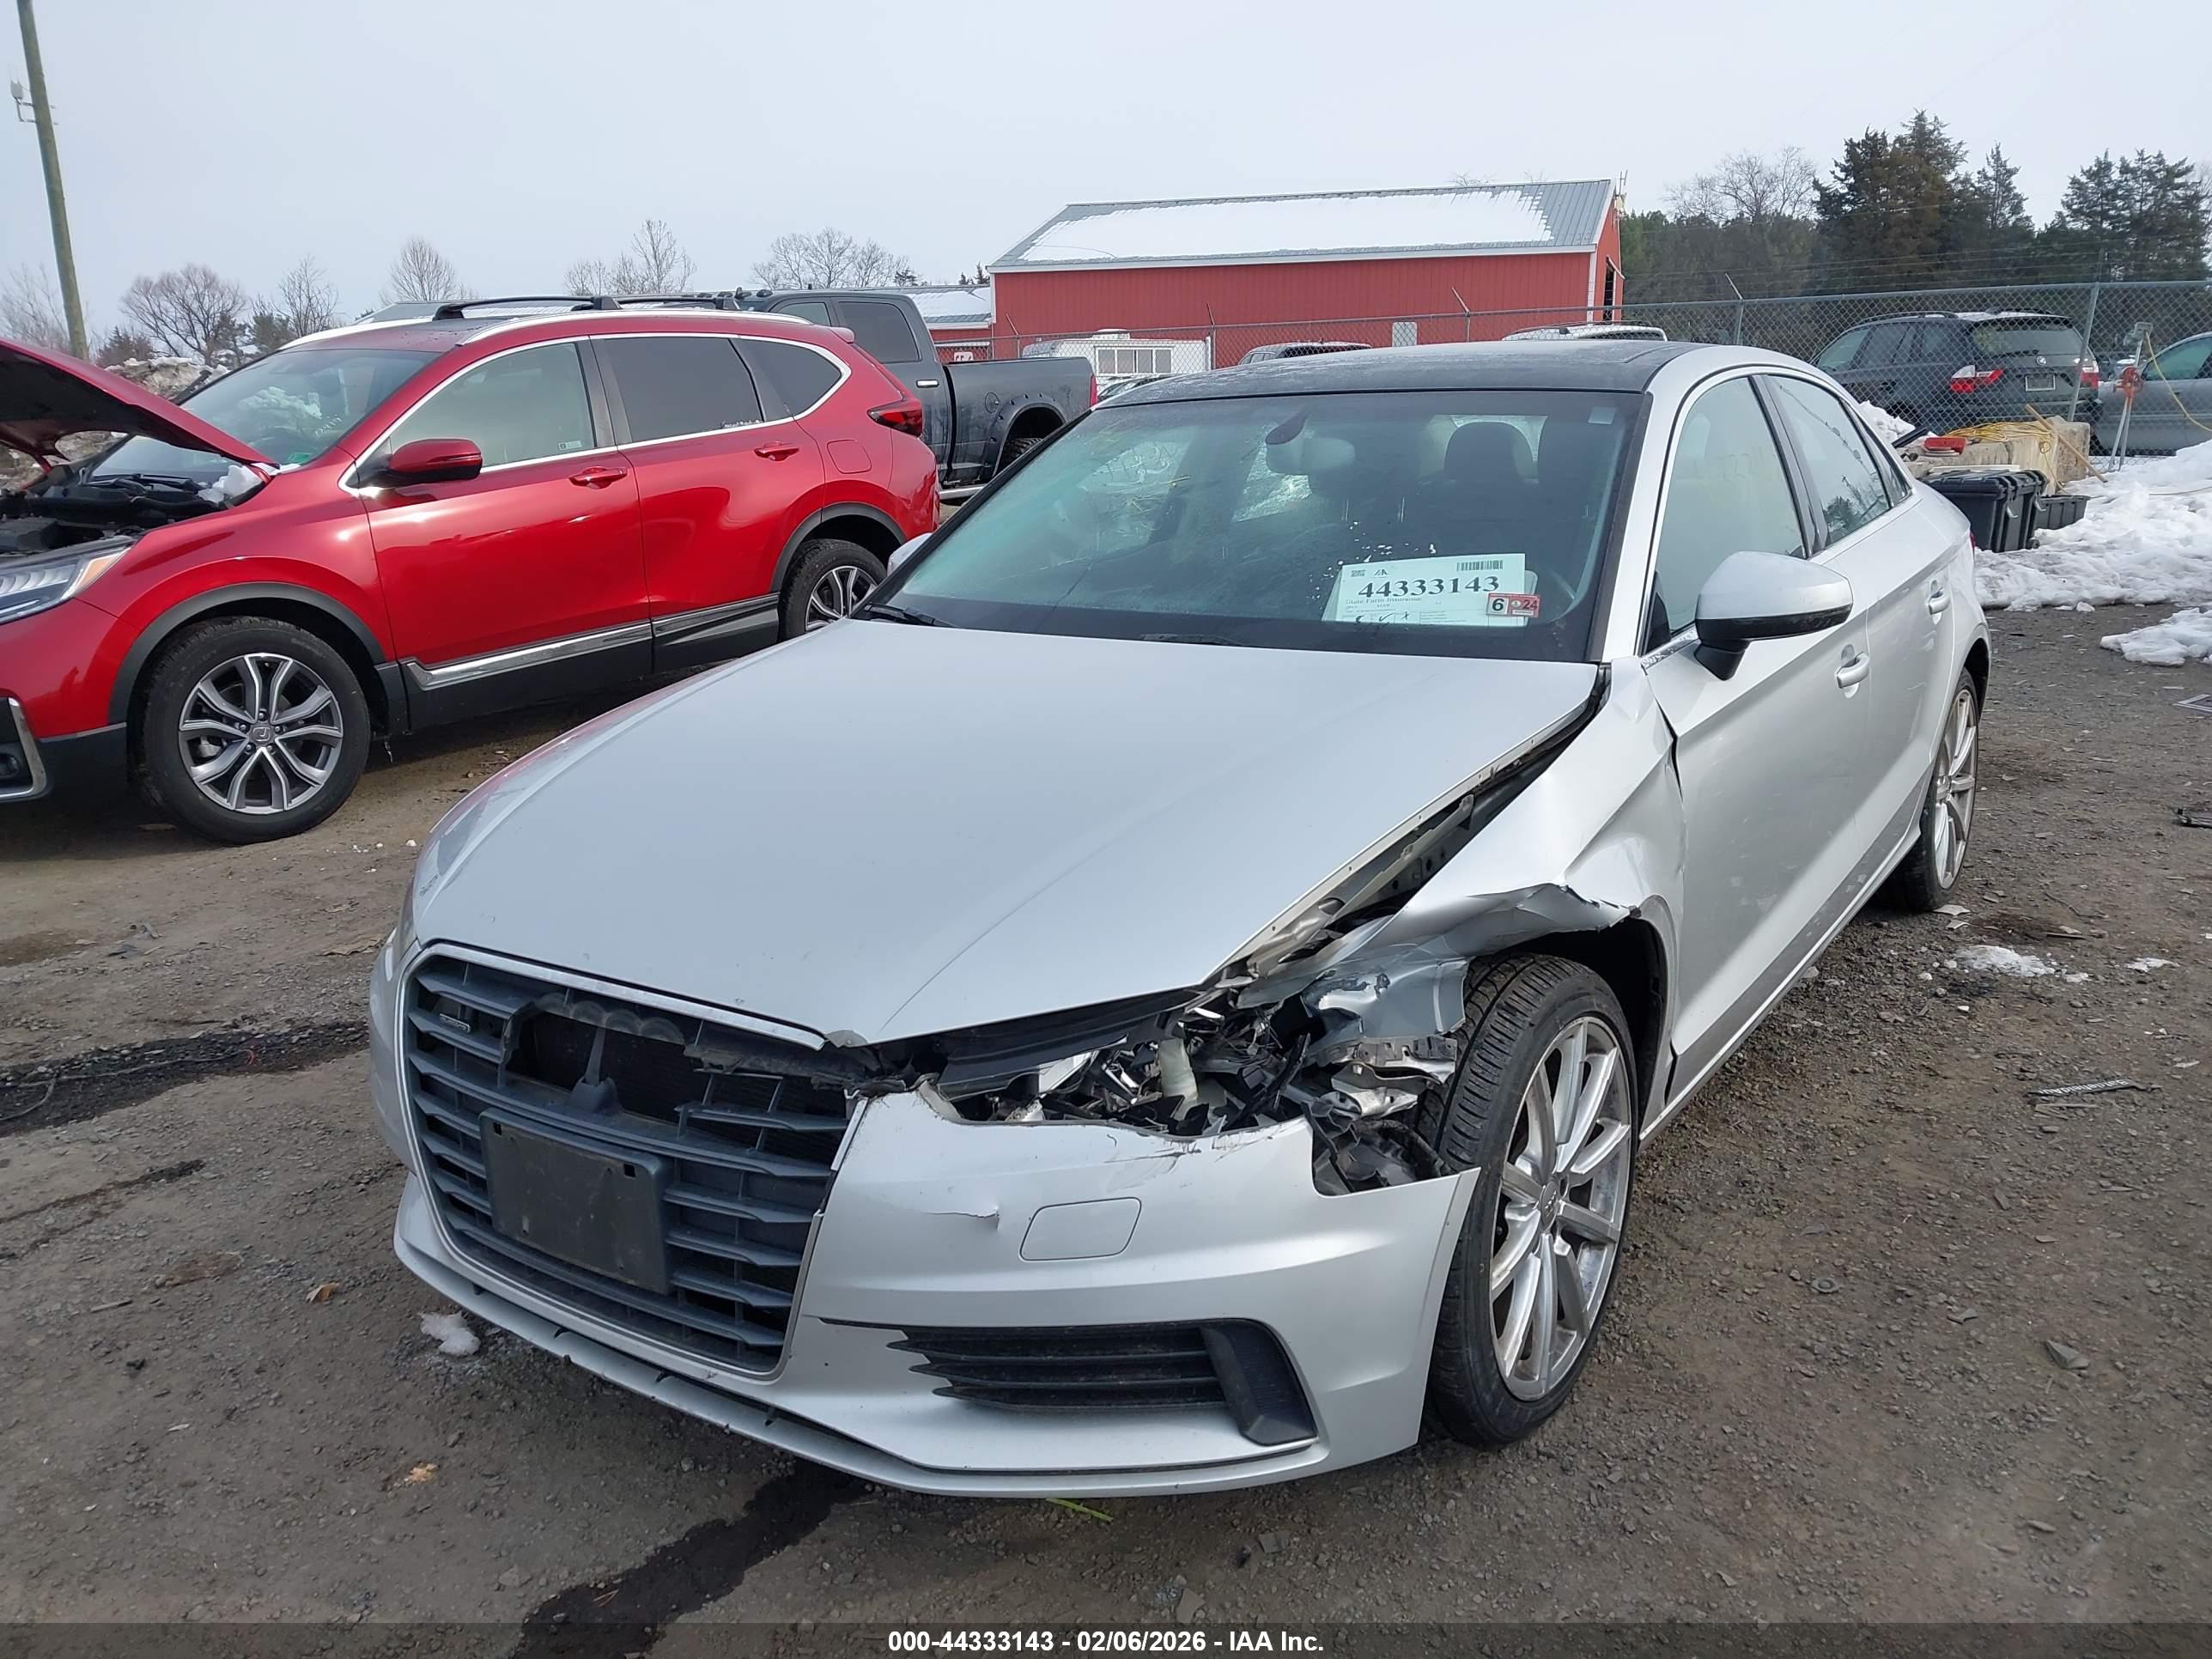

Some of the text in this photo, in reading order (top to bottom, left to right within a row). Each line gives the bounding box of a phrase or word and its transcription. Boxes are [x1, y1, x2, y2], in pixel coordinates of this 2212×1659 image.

[1358, 576, 1499, 598] 44333143
[1492, 598, 1538, 611] 6 24
